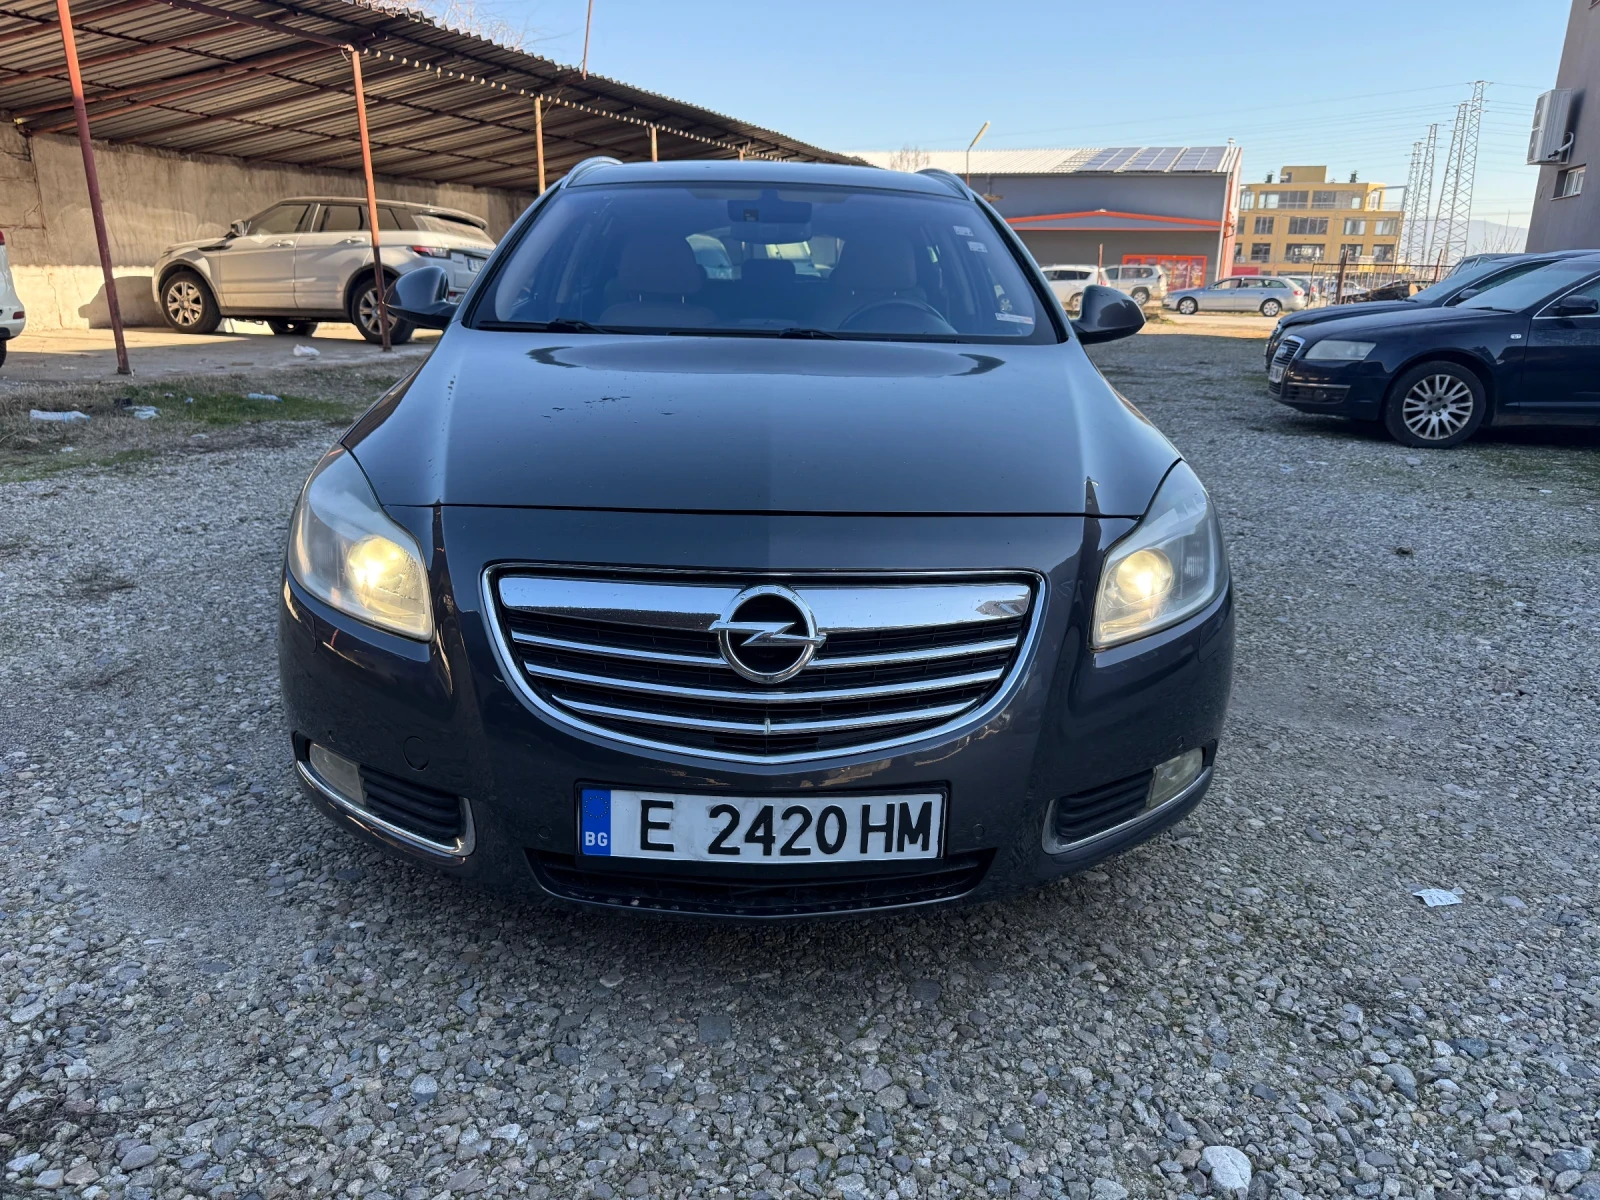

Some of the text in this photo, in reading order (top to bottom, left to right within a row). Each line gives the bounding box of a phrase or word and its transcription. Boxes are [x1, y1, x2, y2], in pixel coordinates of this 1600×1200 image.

[585, 831, 608, 847] BG
[640, 799, 933, 856] E 2420 HM
